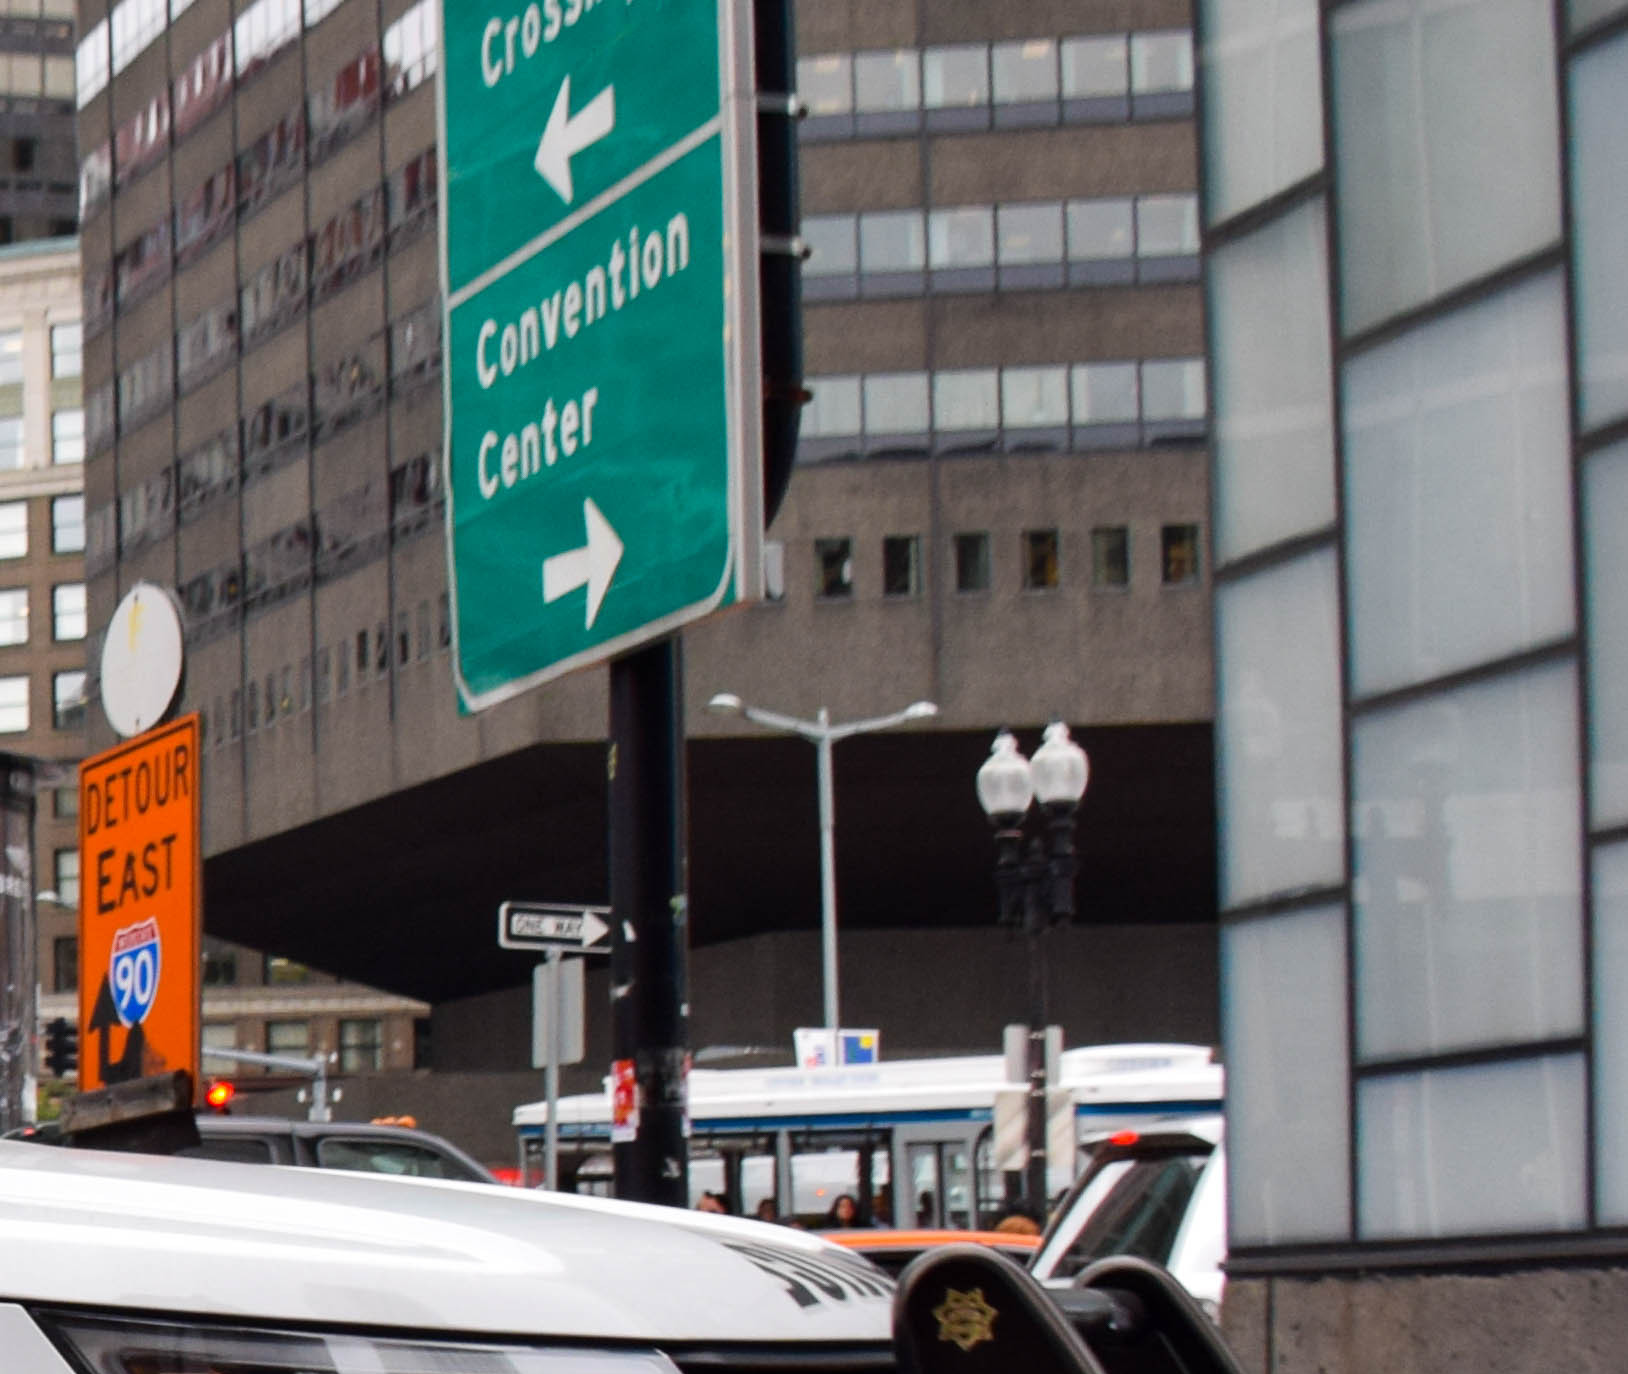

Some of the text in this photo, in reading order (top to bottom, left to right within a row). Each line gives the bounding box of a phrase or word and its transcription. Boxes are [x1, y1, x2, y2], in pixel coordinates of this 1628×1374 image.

[477, 212, 690, 389] Convention
[478, 386, 599, 500] Center
[87, 745, 189, 835] DETOUR
[98, 833, 178, 915] EAST
[116, 949, 154, 1009] 90
